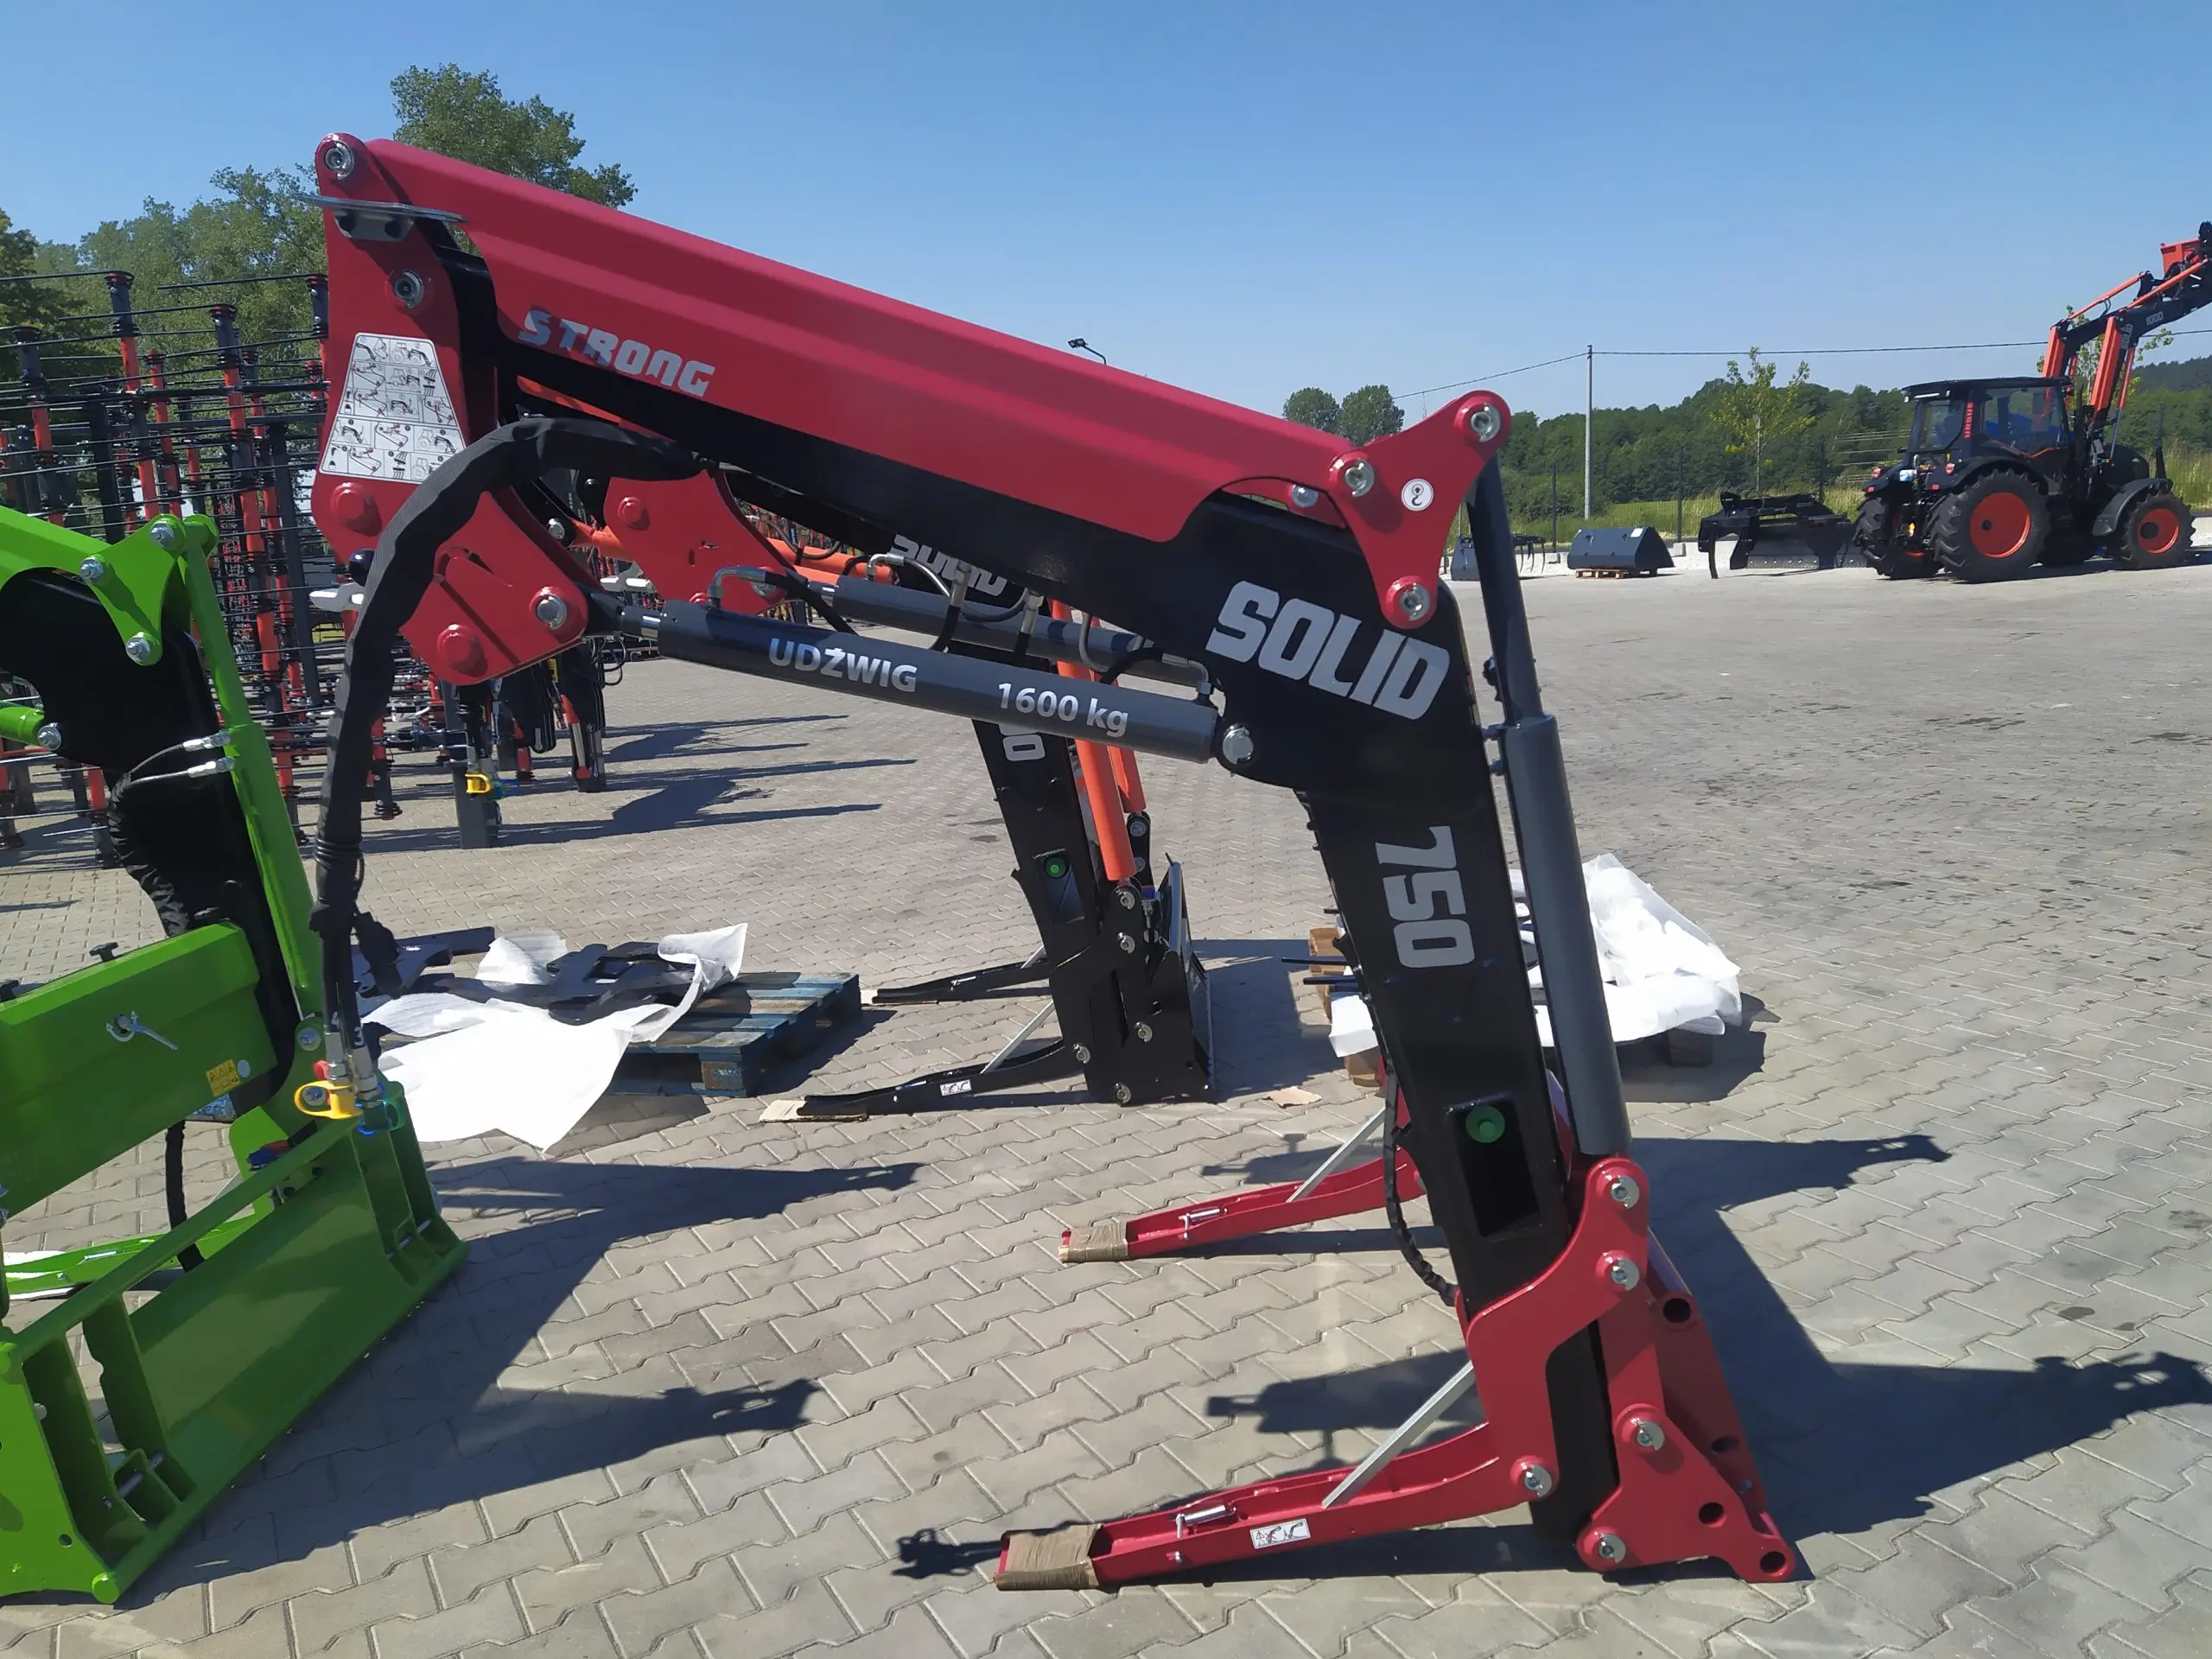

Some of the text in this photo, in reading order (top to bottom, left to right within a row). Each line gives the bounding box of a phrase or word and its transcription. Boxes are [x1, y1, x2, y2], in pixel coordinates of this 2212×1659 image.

[518, 309, 716, 397] STRONG
[1963, 401, 1974, 438] URSUS
[1205, 580, 1450, 720] SOLID
[997, 683, 1079, 722] 1600
[1086, 697, 1129, 738] kg
[1375, 825, 1475, 969] 750
